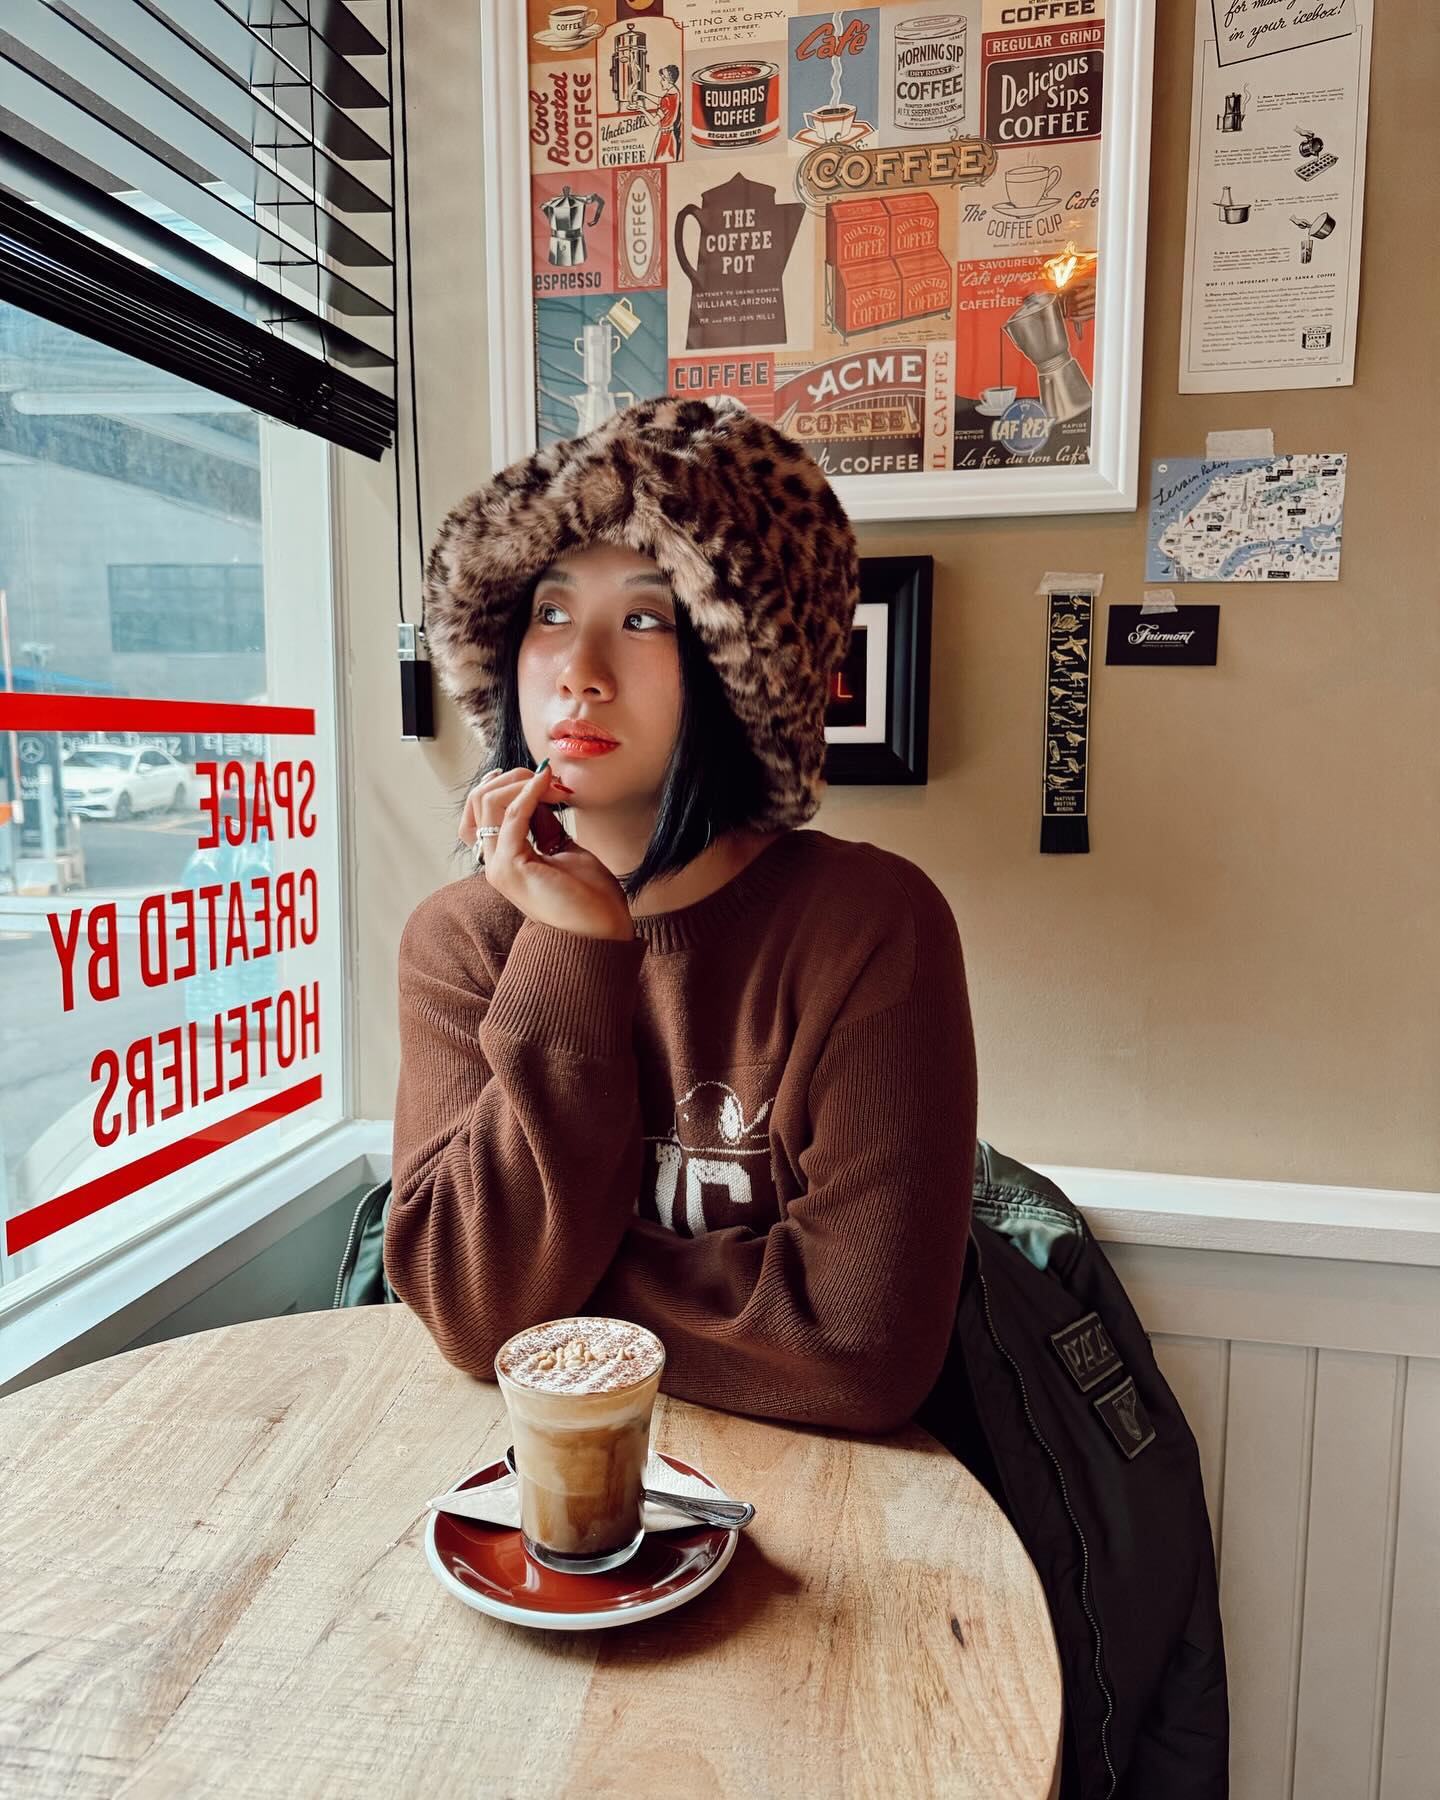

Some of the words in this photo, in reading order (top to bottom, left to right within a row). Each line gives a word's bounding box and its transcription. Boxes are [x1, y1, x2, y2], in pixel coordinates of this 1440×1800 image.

[728, 15, 738, 24] &
[743, 10, 786, 22] GRAY,
[1001, 0, 1095, 24] COFFEE
[1224, 0, 1248, 28] for
[556, 22, 582, 31] COFFEE
[1229, 27, 1245, 42] in
[1250, 17, 1288, 49] your
[1292, 0, 1346, 26] icebox!
[795, 18, 870, 61] Café
[992, 34, 1053, 54] REGULAR
[1060, 28, 1102, 46] GRIND
[897, 44, 945, 72] MORNING
[945, 44, 964, 63] SIP
[705, 85, 765, 108] EDWARDS
[896, 73, 963, 101] COFFEE
[1001, 56, 1089, 115] Delicious
[1046, 84, 1089, 112] Sips
[547, 71, 571, 167] Roasted
[572, 73, 594, 164] COFFEE
[713, 107, 756, 126] COFFEE
[998, 110, 1090, 140] COFFEE
[601, 120, 625, 142] Uncle
[739, 128, 762, 138] GRIND
[602, 149, 647, 167] COFFEE
[622, 143, 646, 151] SPECIAL
[809, 143, 987, 190] COFFEE
[722, 208, 756, 229] THE
[961, 203, 988, 223] The
[631, 191, 648, 266] COFFEE
[843, 224, 886, 243] ROASTED
[896, 216, 935, 234] ROASTED
[986, 219, 1034, 240] COFFEE
[1036, 213, 1063, 237] CUP
[706, 230, 773, 253] COFFEE
[844, 237, 886, 260] COFFEE
[897, 229, 935, 249] COFFEE
[722, 254, 755, 275] POT
[959, 263, 974, 272] UN
[979, 256, 1044, 271] SAVOUREUX
[852, 287, 897, 309] ROASTED
[908, 277, 948, 297] ROASTED
[740, 296, 778, 306] ARIZONA
[908, 290, 949, 312] COFFEE
[853, 301, 897, 326] COFFEE
[673, 361, 770, 392] COFFEE
[806, 355, 923, 404] ACME
[796, 409, 906, 436] COFFEE
[839, 453, 919, 474] COFFEE
[957, 448, 977, 467] La
[1005, 453, 1024, 465] du
[1027, 451, 1051, 464] bon
[1127, 622, 1196, 645] Fairmont
